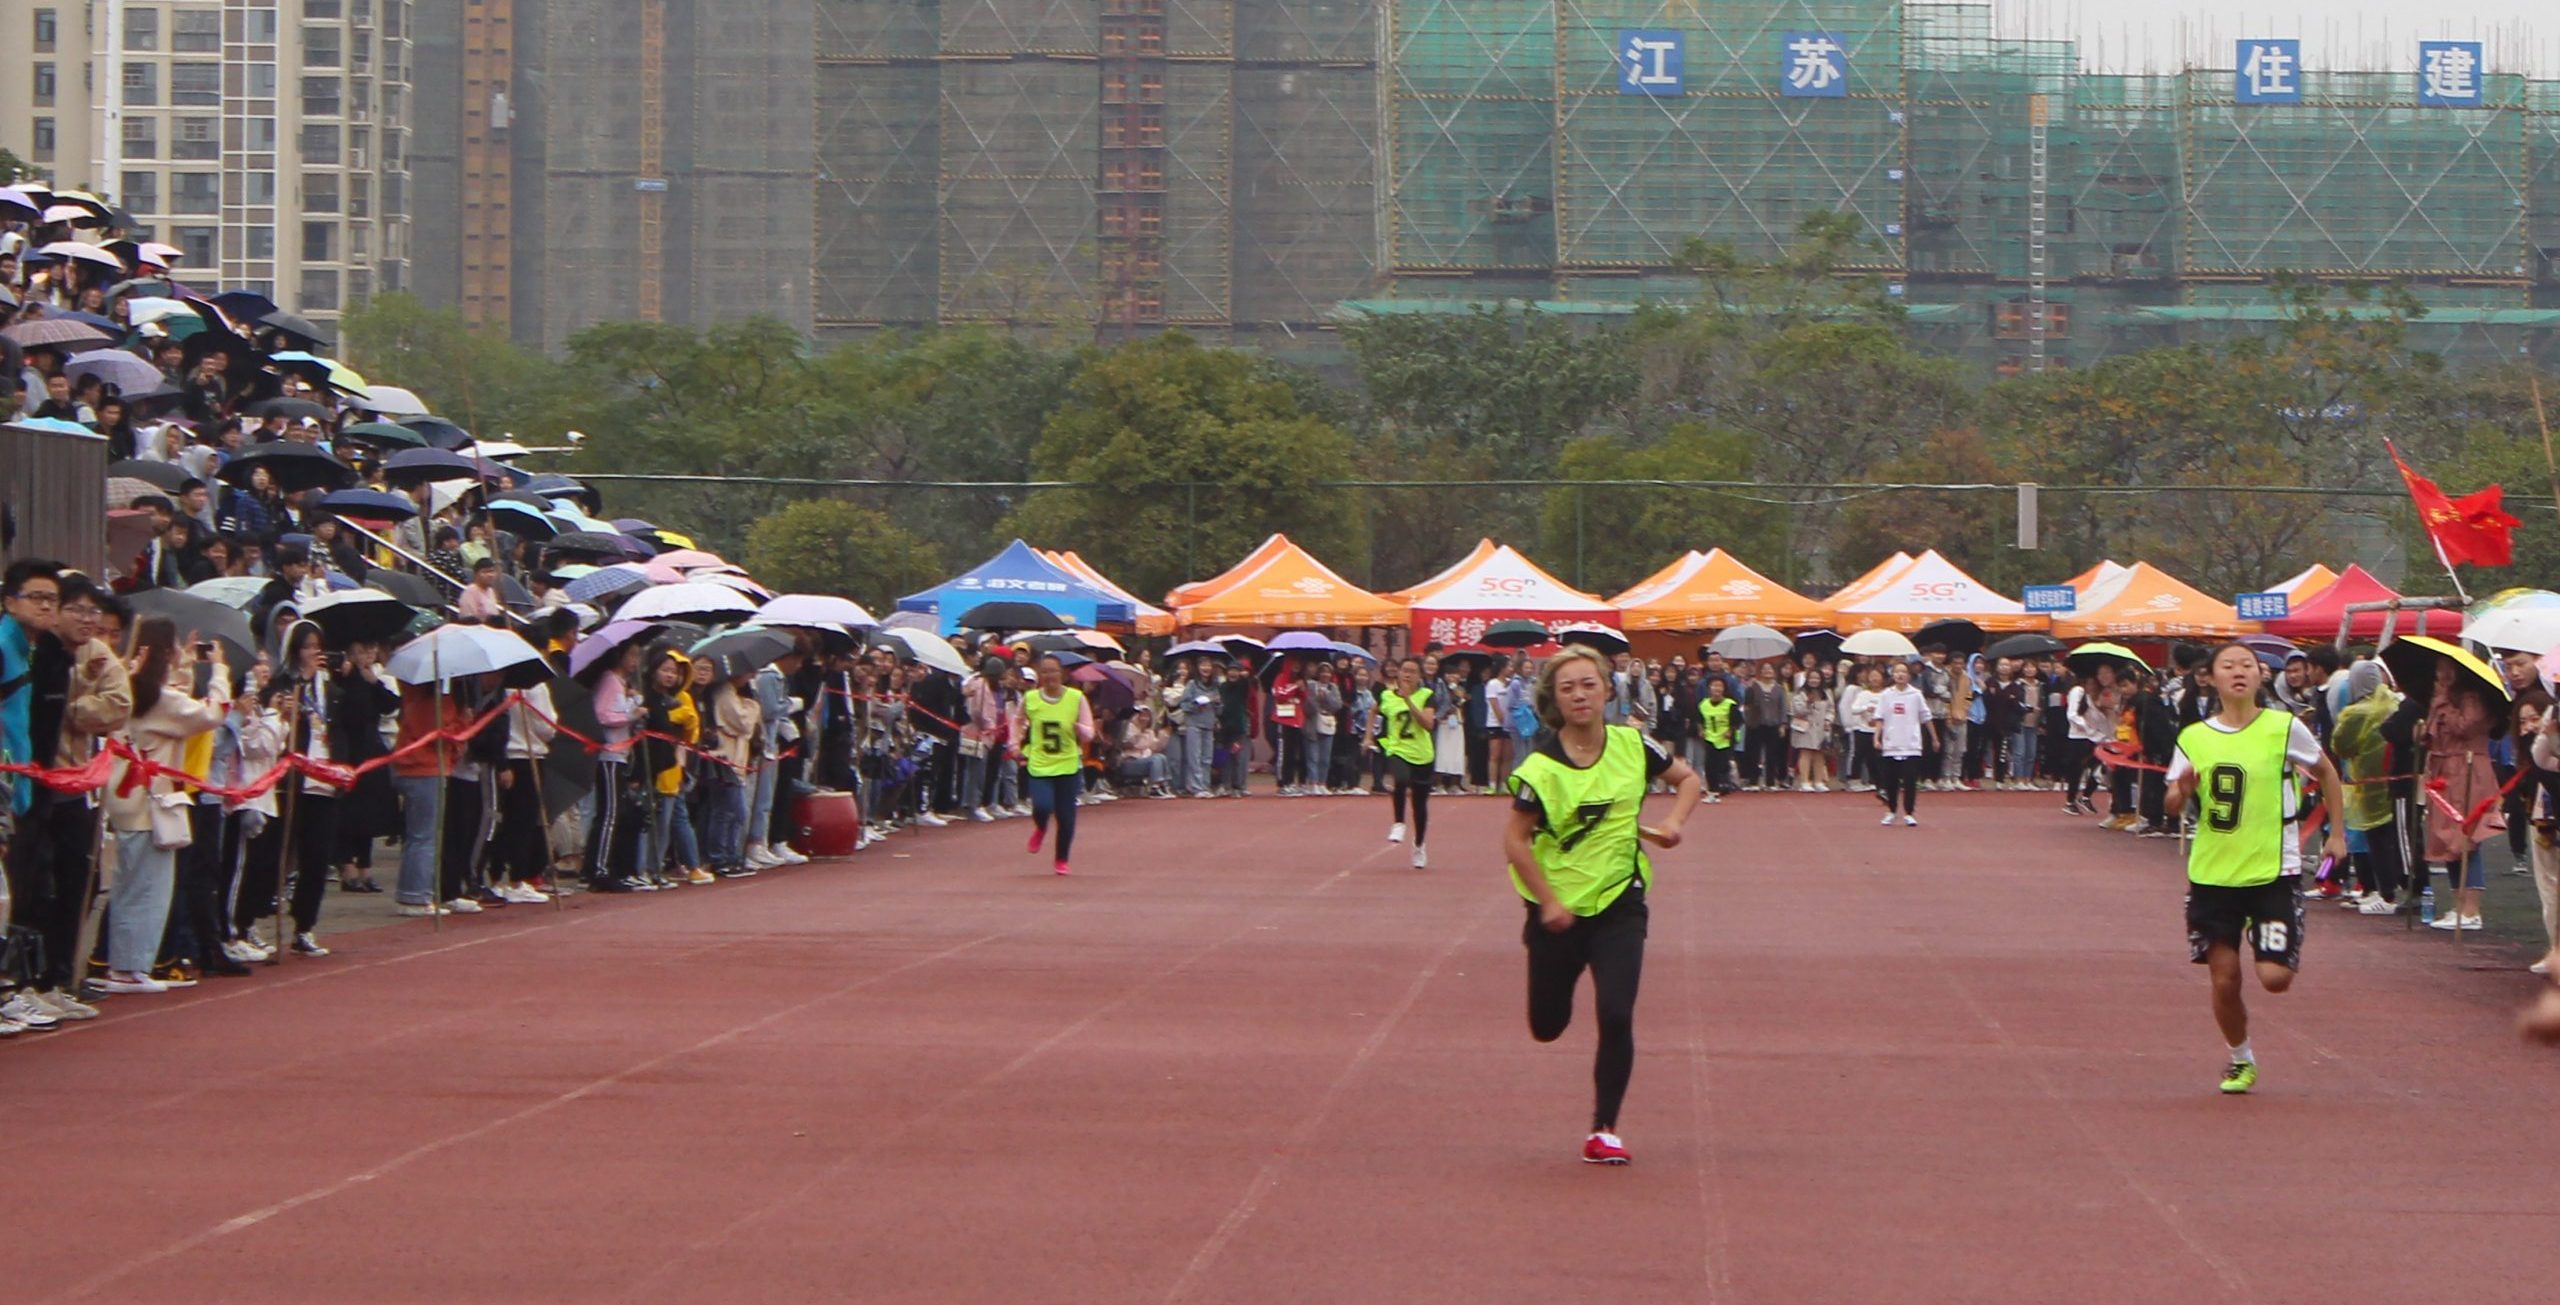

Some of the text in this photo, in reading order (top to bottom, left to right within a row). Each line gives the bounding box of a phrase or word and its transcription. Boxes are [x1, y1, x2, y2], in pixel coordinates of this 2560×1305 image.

[1041, 720, 1061, 755] 5
[1396, 710, 1414, 739] 2
[2208, 763, 2247, 834] 9
[1557, 799, 1615, 854] 7
[2259, 920, 2288, 952] 16
